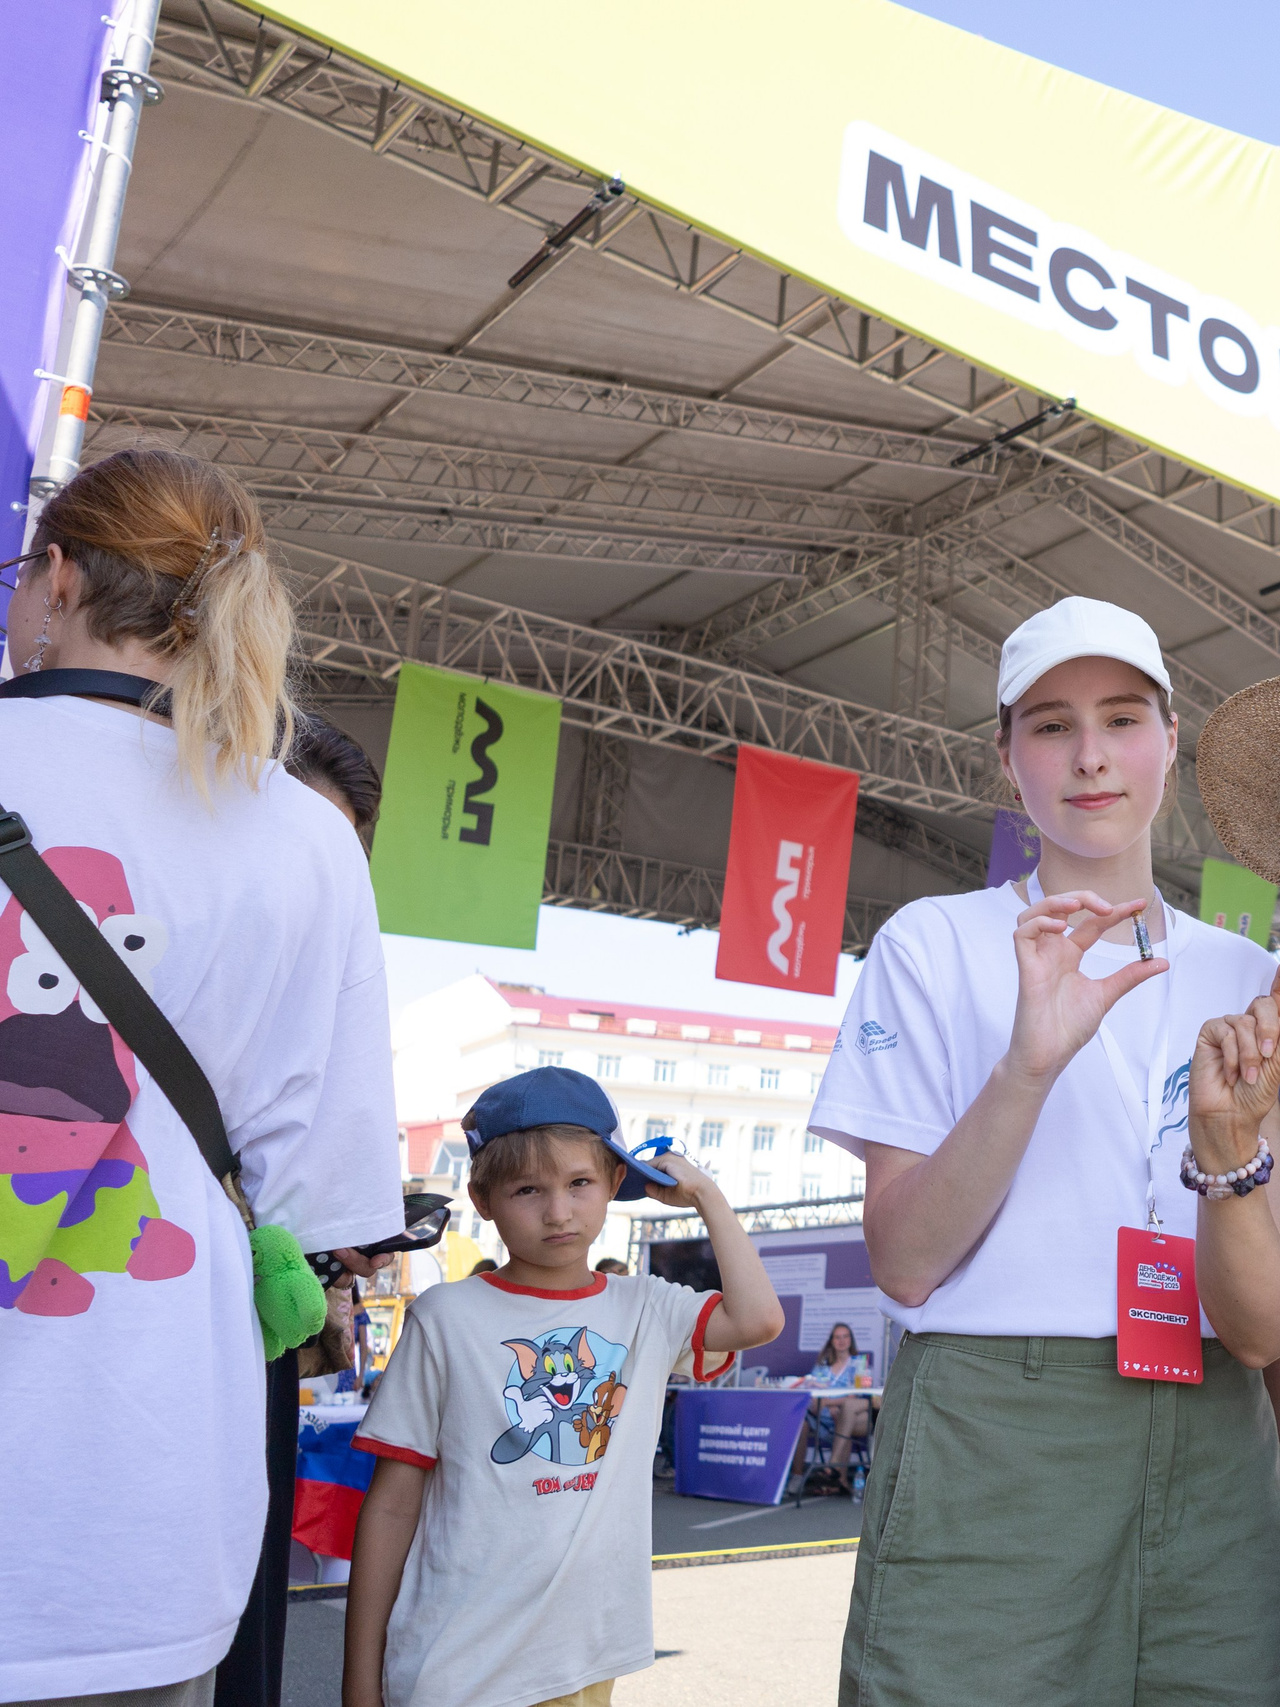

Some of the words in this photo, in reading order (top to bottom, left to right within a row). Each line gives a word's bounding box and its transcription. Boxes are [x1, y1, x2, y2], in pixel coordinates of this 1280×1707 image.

[862, 149, 1260, 394] МЕСТО
[868, 1032, 898, 1046] Speed
[867, 1041, 898, 1055] cubing
[1138, 1264, 1156, 1273] ДЕНЬ
[1164, 1282, 1180, 1290] 2025
[1130, 1309, 1188, 1324] ЭКСПОНЕНТ
[532, 1475, 562, 1496] TOM
